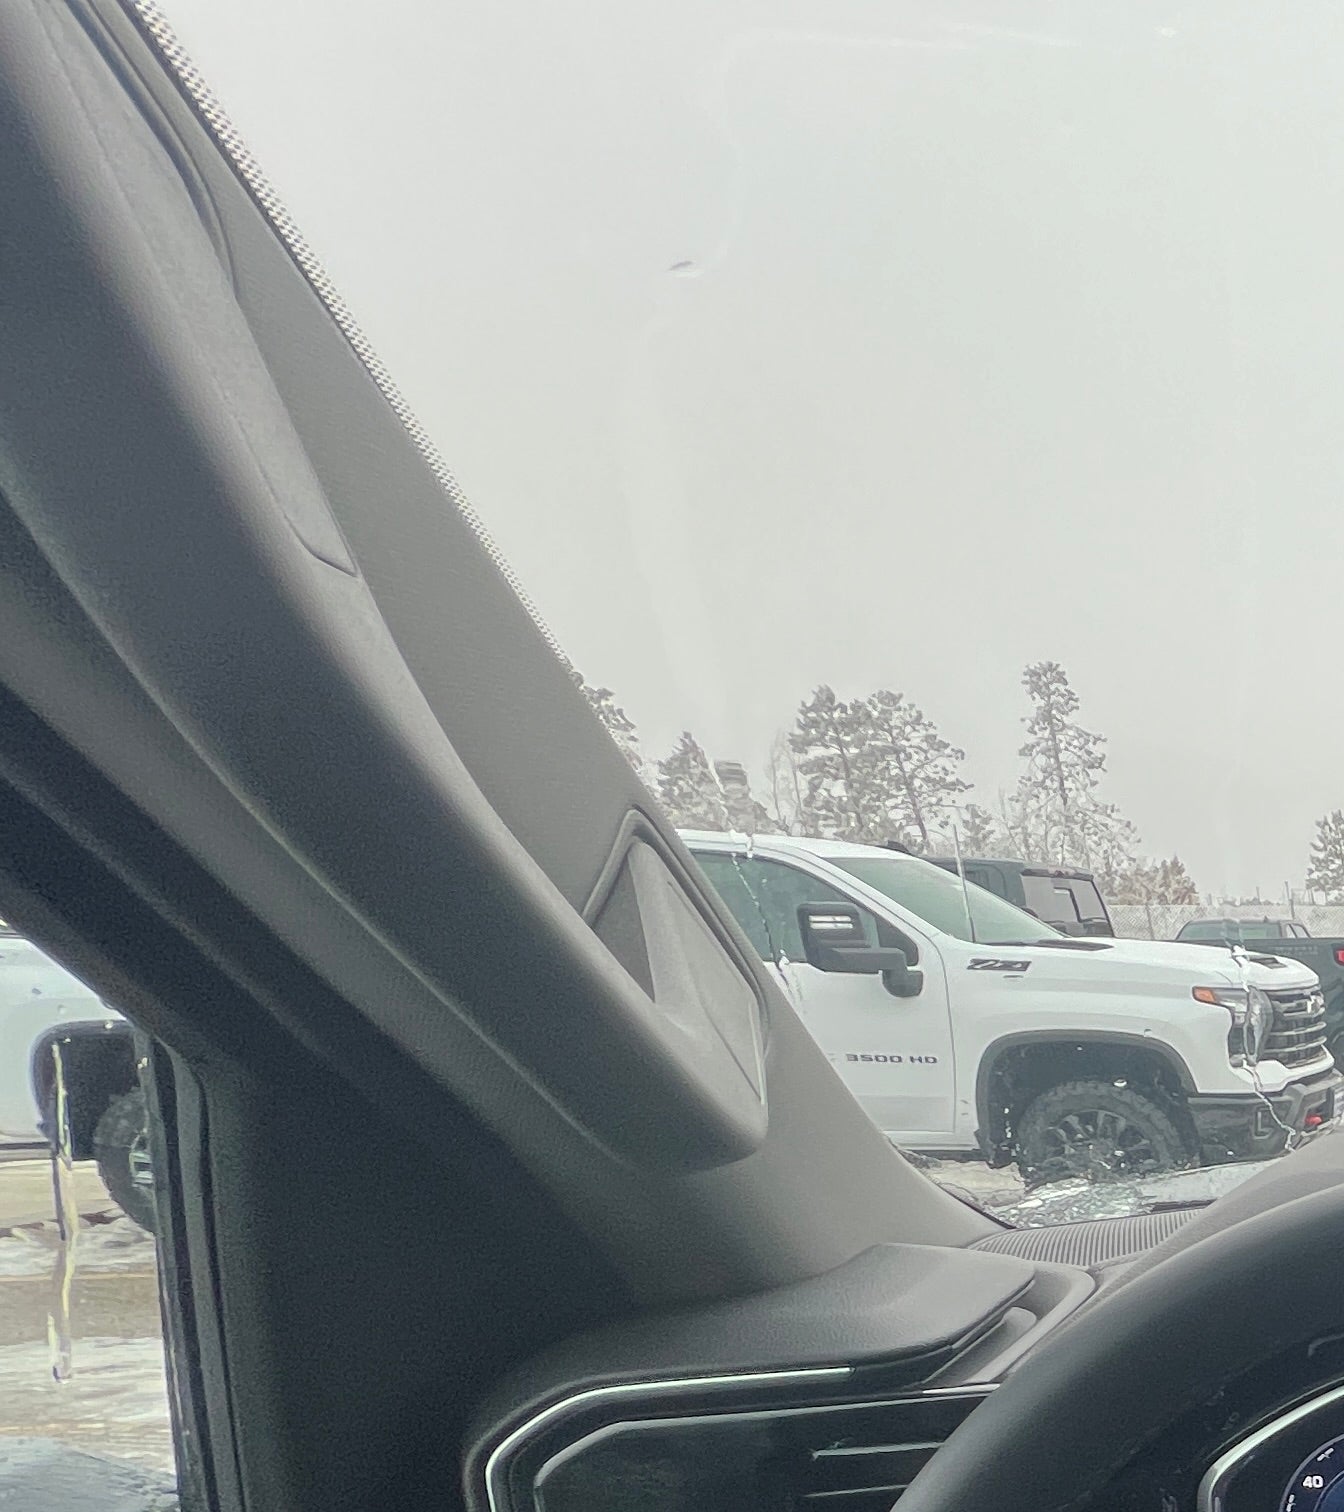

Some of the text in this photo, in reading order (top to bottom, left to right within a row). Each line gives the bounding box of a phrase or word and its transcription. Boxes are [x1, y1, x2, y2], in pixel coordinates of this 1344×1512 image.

[847, 1053, 938, 1064] 3500 HD
[1303, 1475, 1324, 1488] 40
